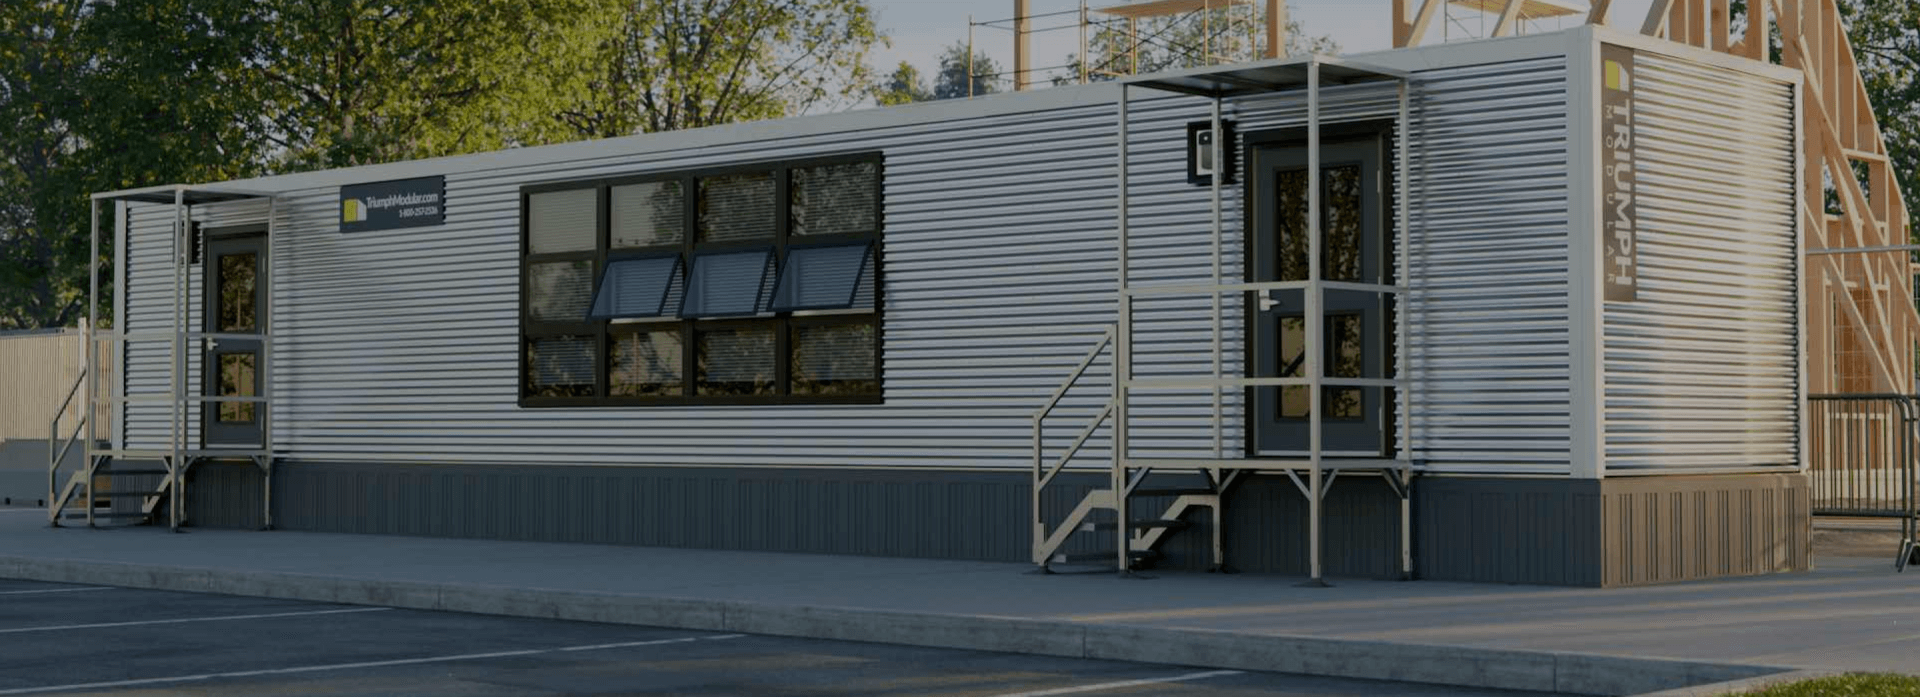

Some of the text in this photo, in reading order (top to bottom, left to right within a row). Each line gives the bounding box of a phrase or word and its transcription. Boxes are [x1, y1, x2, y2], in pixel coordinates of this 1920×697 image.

[366, 193, 438, 209] TriumphModular.com
[1605, 104, 1615, 283] MODULAR
[1613, 98, 1632, 286] TRIUMPH
